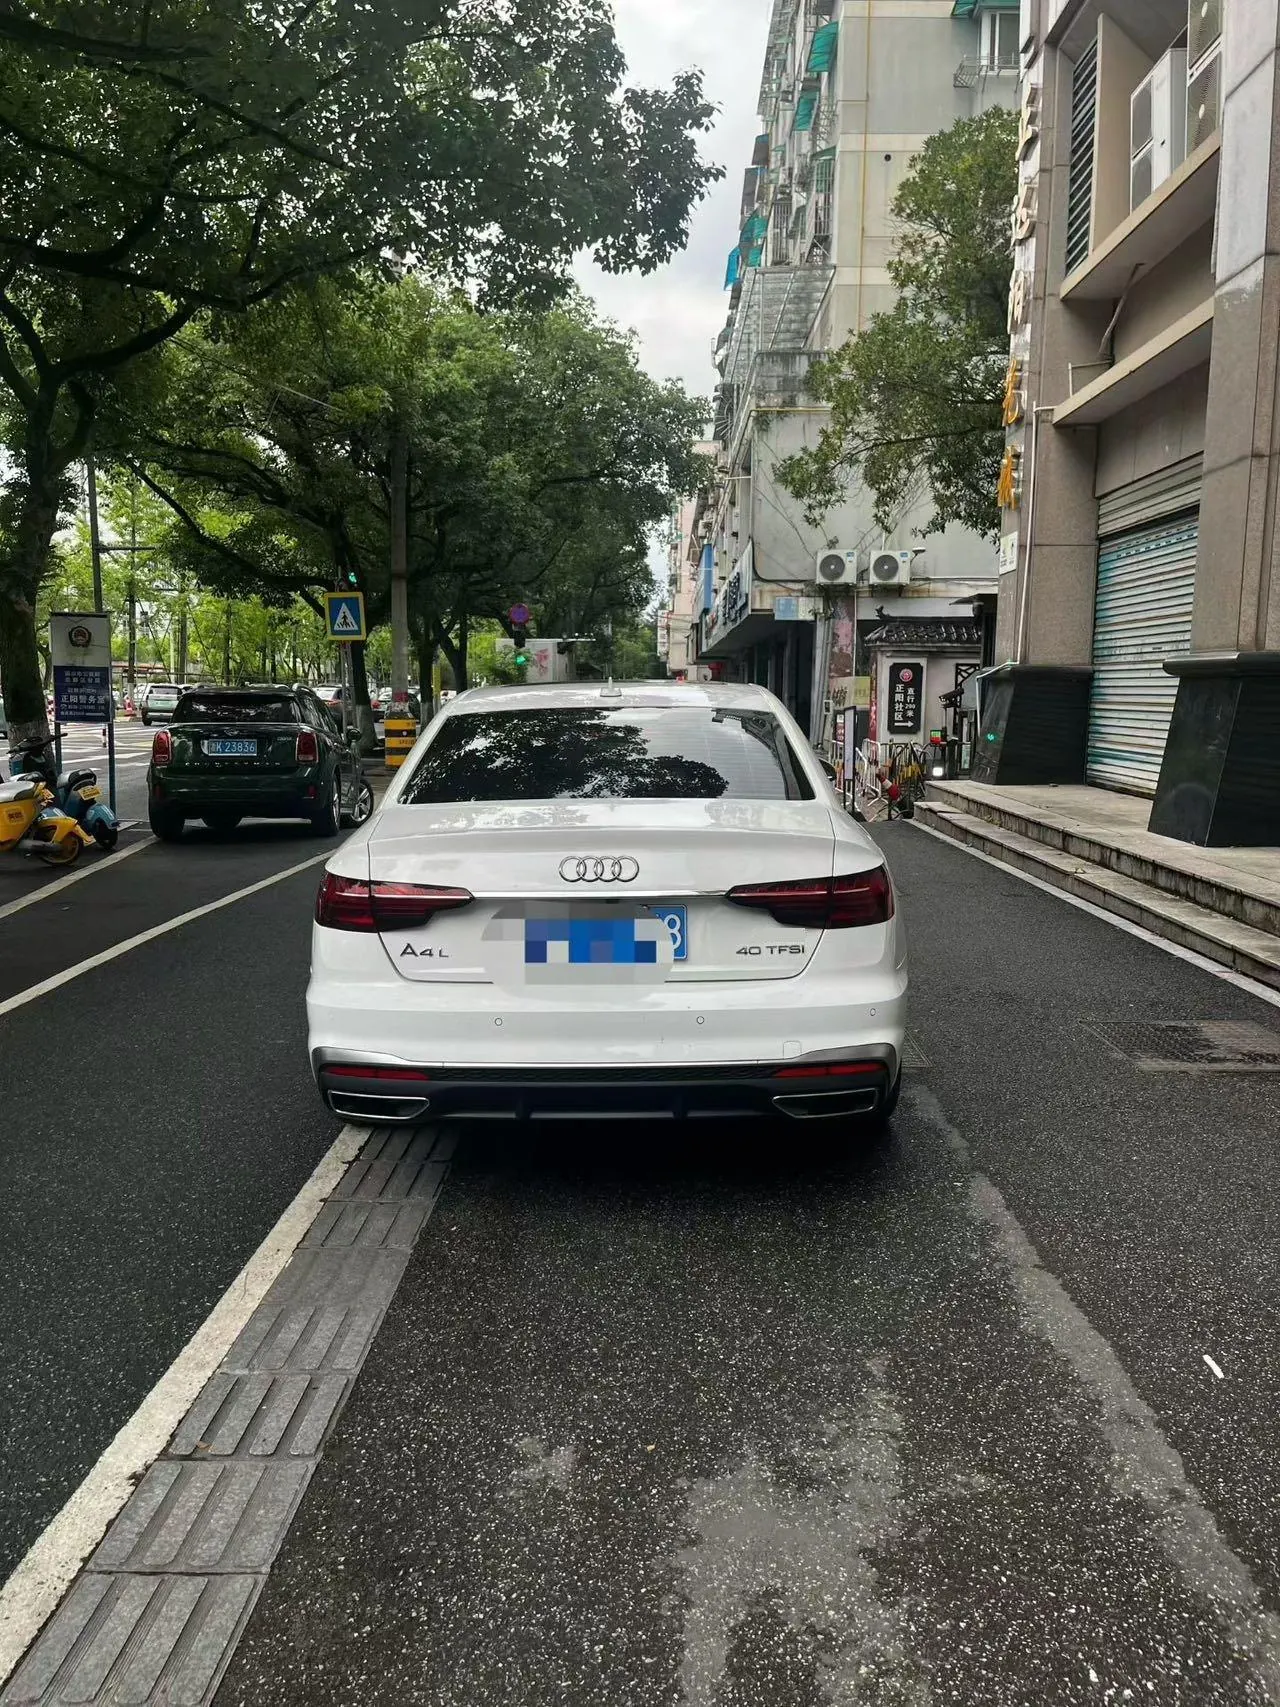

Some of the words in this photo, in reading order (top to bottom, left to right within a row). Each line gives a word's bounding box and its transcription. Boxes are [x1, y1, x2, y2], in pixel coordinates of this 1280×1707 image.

[894, 683, 904, 721] 正阳社区
[736, 945, 762, 956] 40
[765, 944, 805, 955] TFSI
